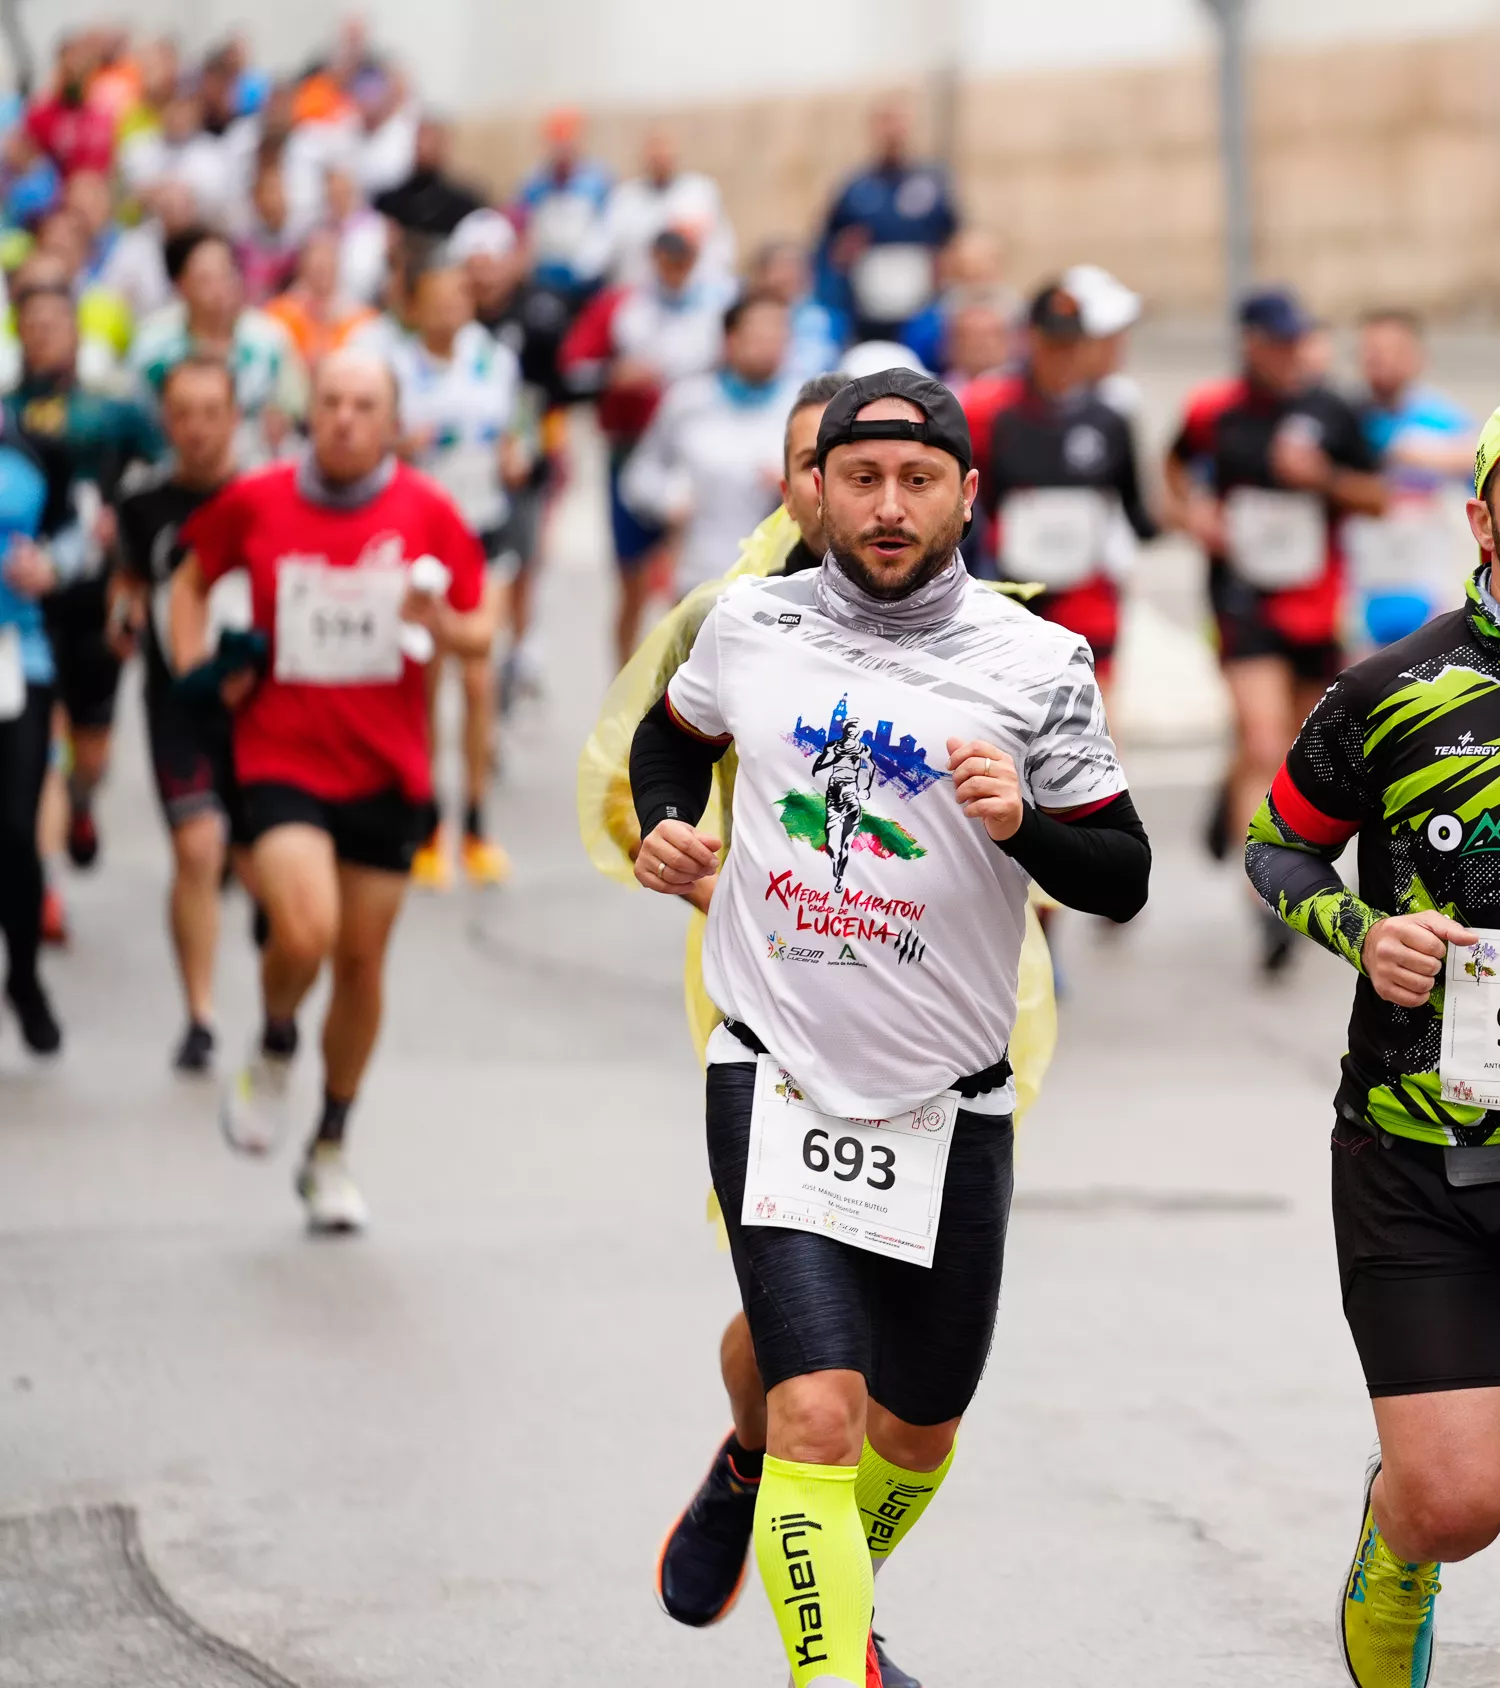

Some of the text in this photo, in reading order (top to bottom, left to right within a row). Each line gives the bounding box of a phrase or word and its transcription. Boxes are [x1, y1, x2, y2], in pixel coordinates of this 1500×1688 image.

[1434, 744, 1500, 756] TEAMERGY
[796, 905, 900, 944] LUCENA
[802, 1128, 896, 1191] 693
[771, 1512, 828, 1668] kalenji
